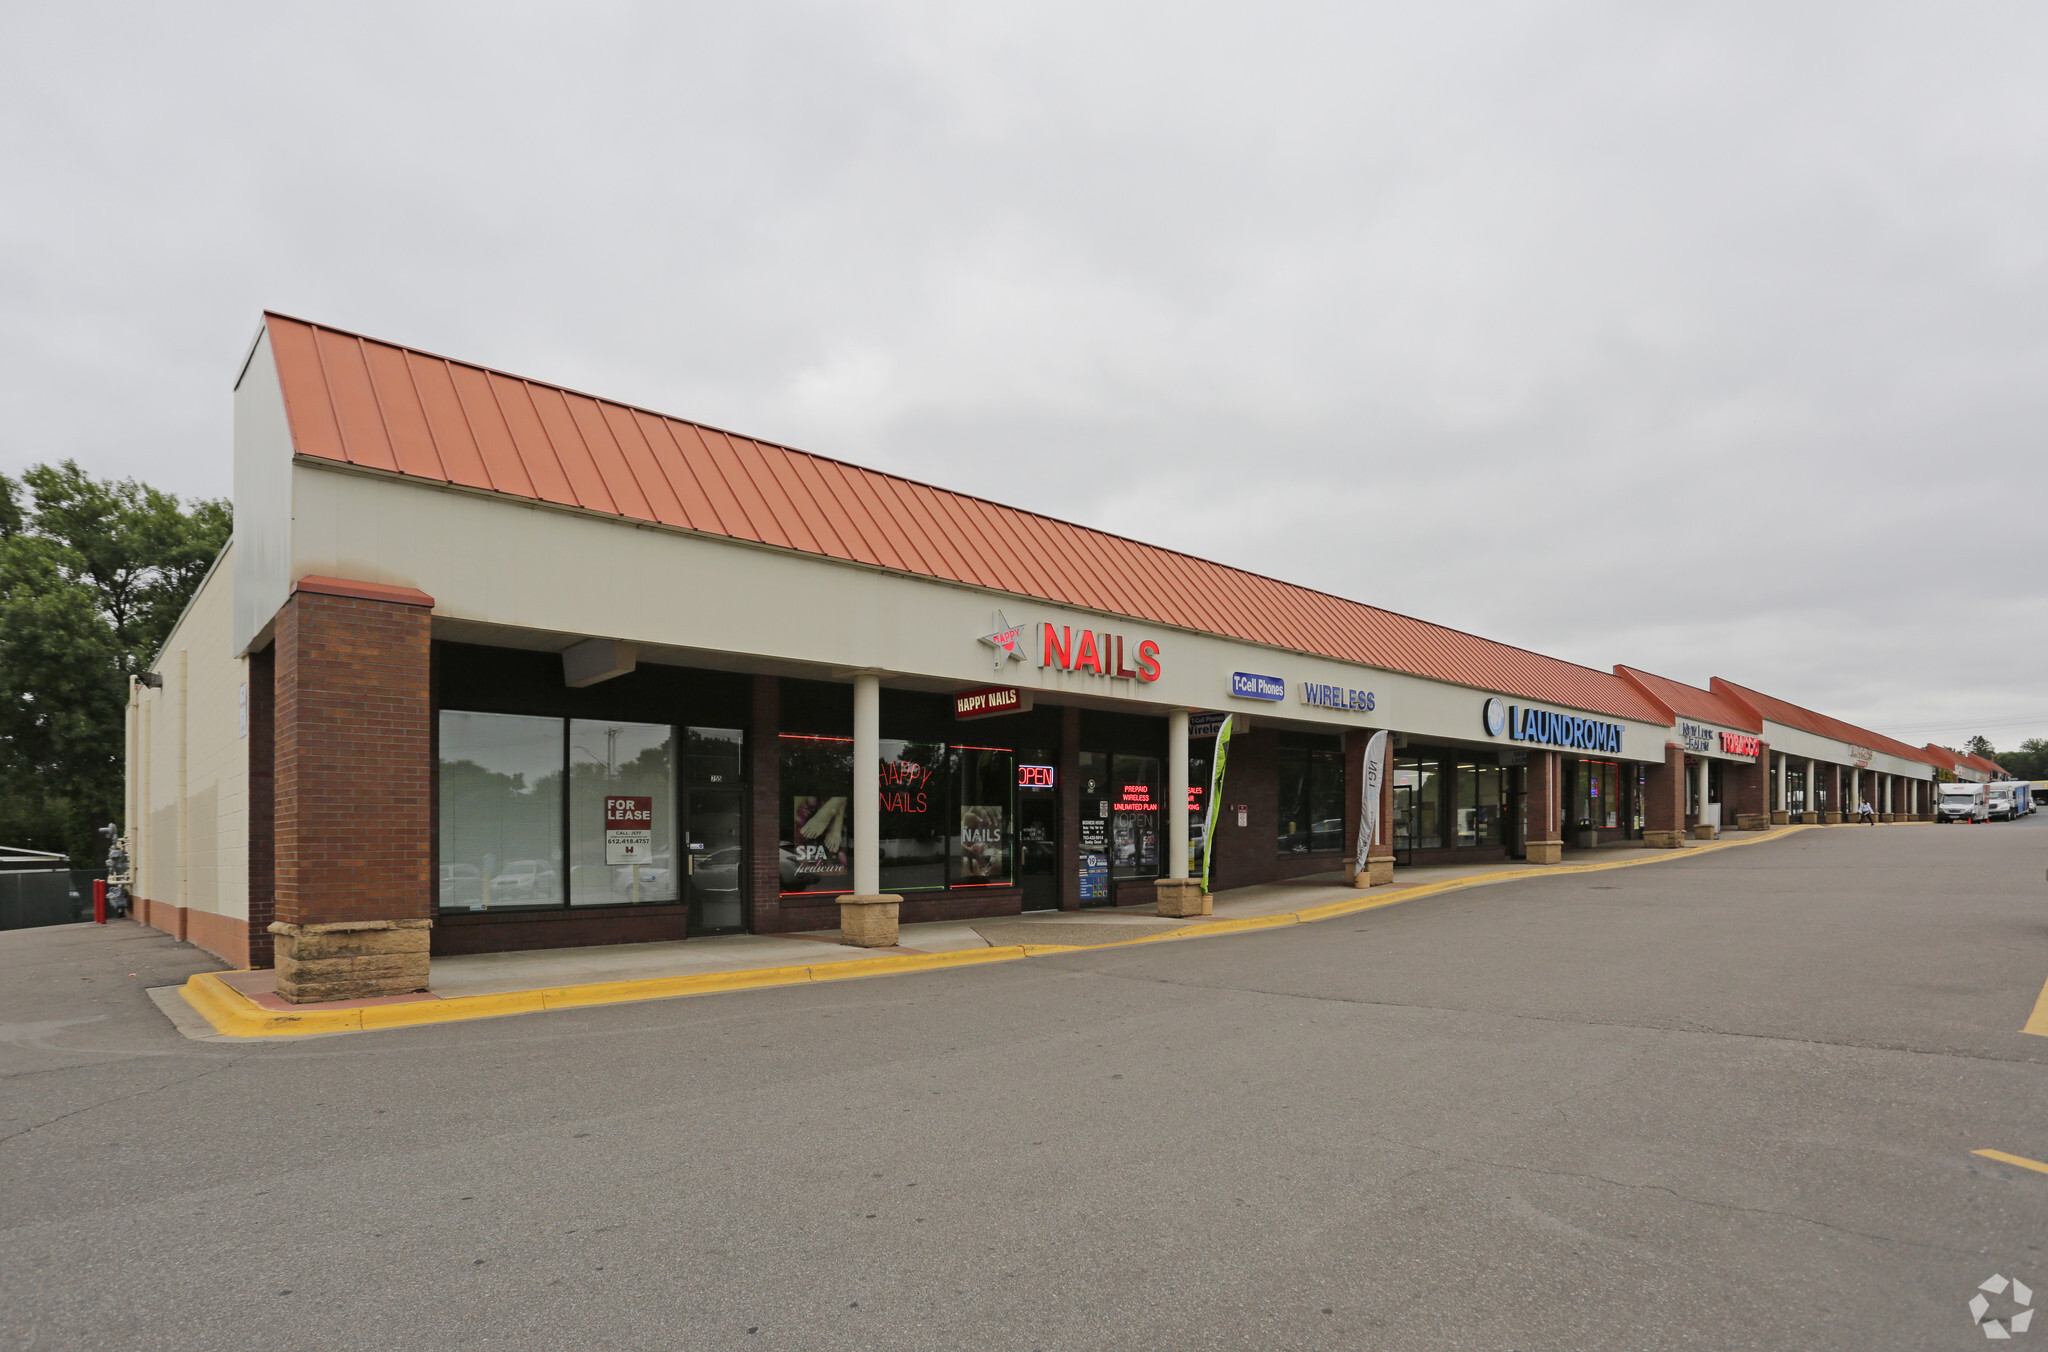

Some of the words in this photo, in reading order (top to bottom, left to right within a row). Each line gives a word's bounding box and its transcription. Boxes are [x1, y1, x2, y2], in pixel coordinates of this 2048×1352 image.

[993, 628, 1020, 644] HAPPY
[1042, 622, 1162, 682] NAILS
[1234, 675, 1256, 693] T-Cell
[1258, 679, 1284, 697] Phones
[957, 695, 986, 713] HAPPY
[988, 689, 1017, 707] NAILS
[1304, 682, 1375, 712] WIRELESS
[1513, 705, 1625, 753] LAUNDROMAT
[1721, 732, 1760, 757] TOBACCO
[879, 760, 933, 789] HAPPY
[1018, 767, 1053, 785] OPEN
[1122, 793, 1150, 802] WIRELESS
[1124, 785, 1148, 793] PREPAID
[607, 799, 635, 810] FOR
[879, 792, 927, 813] NAILS
[1113, 803, 1142, 811] UNLIMITED
[1143, 803, 1158, 811] PLAN
[607, 810, 651, 820] LEASE
[1120, 813, 1153, 828] OPEN
[961, 827, 1001, 843] NAILS
[795, 845, 827, 861] SPA
[794, 859, 845, 876] pedicure
